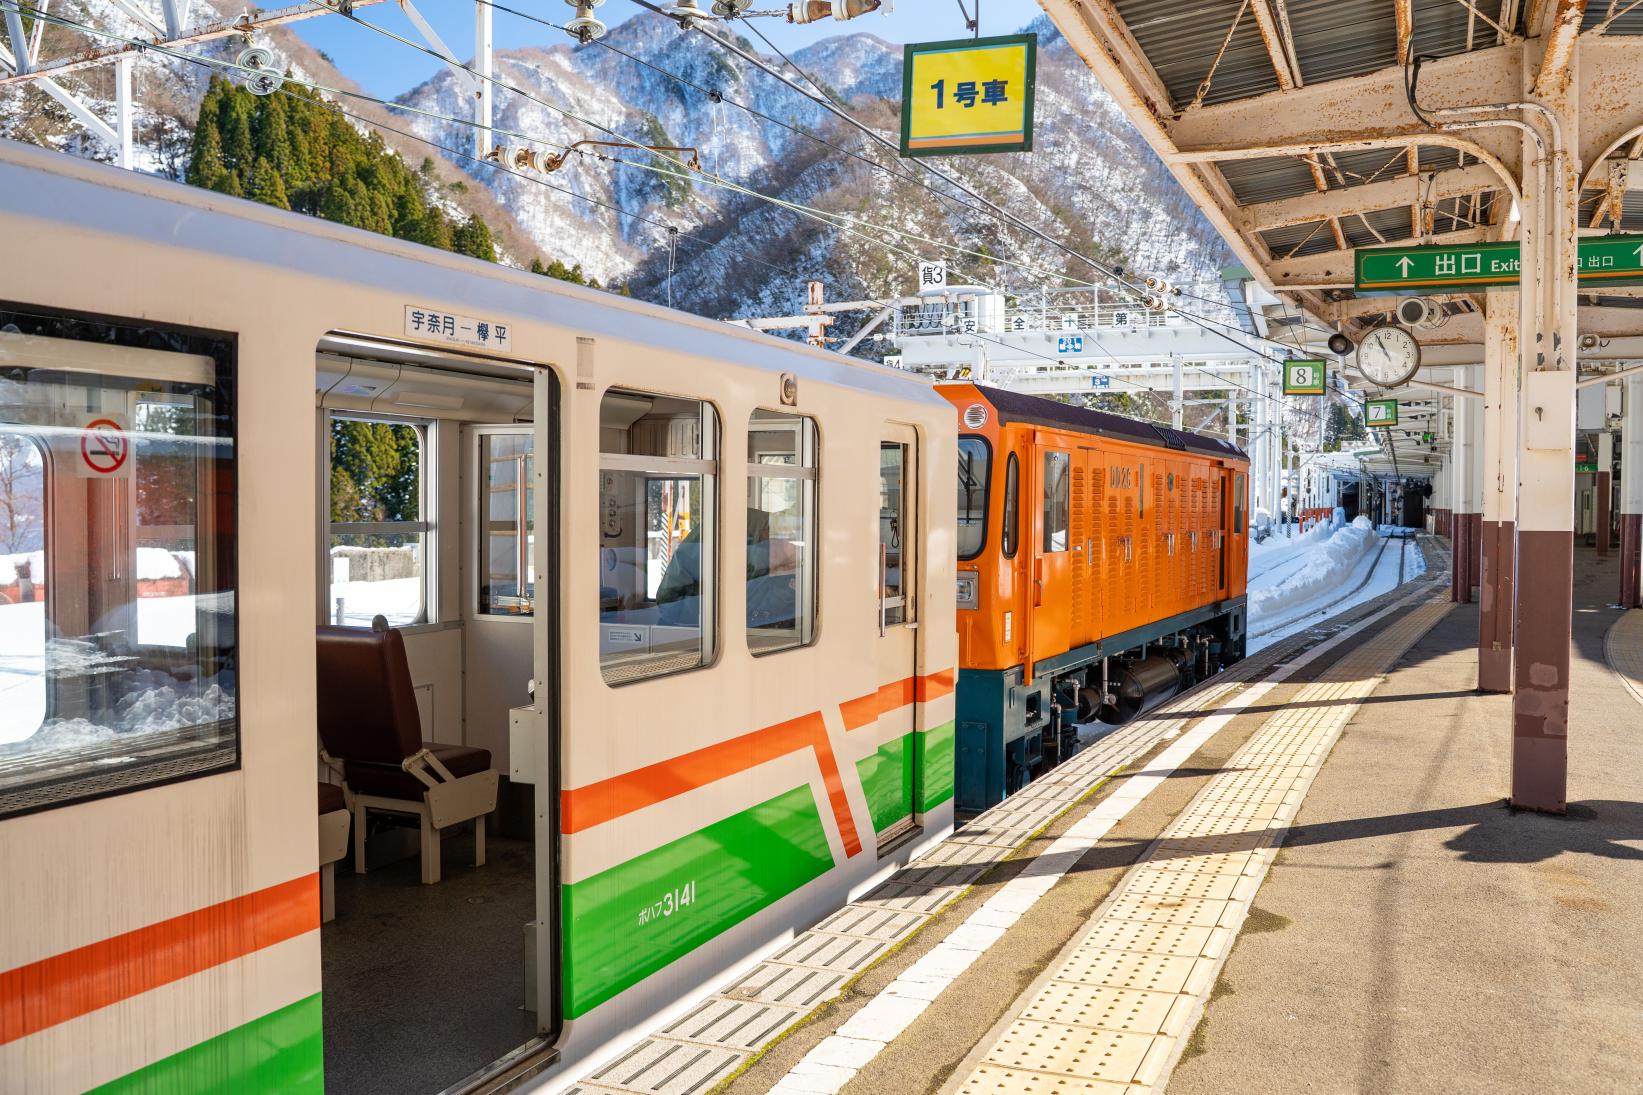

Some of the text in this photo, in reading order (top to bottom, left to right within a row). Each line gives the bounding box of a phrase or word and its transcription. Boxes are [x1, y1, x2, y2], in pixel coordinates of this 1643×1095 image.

[929, 79, 1009, 110] 1号車
[1435, 253, 1482, 276] 出口
[1491, 259, 1520, 272] Exit
[1588, 255, 1614, 268] 出口
[922, 266, 943, 285] 貨3
[1296, 368, 1307, 385] 8
[1373, 406, 1381, 419] 7
